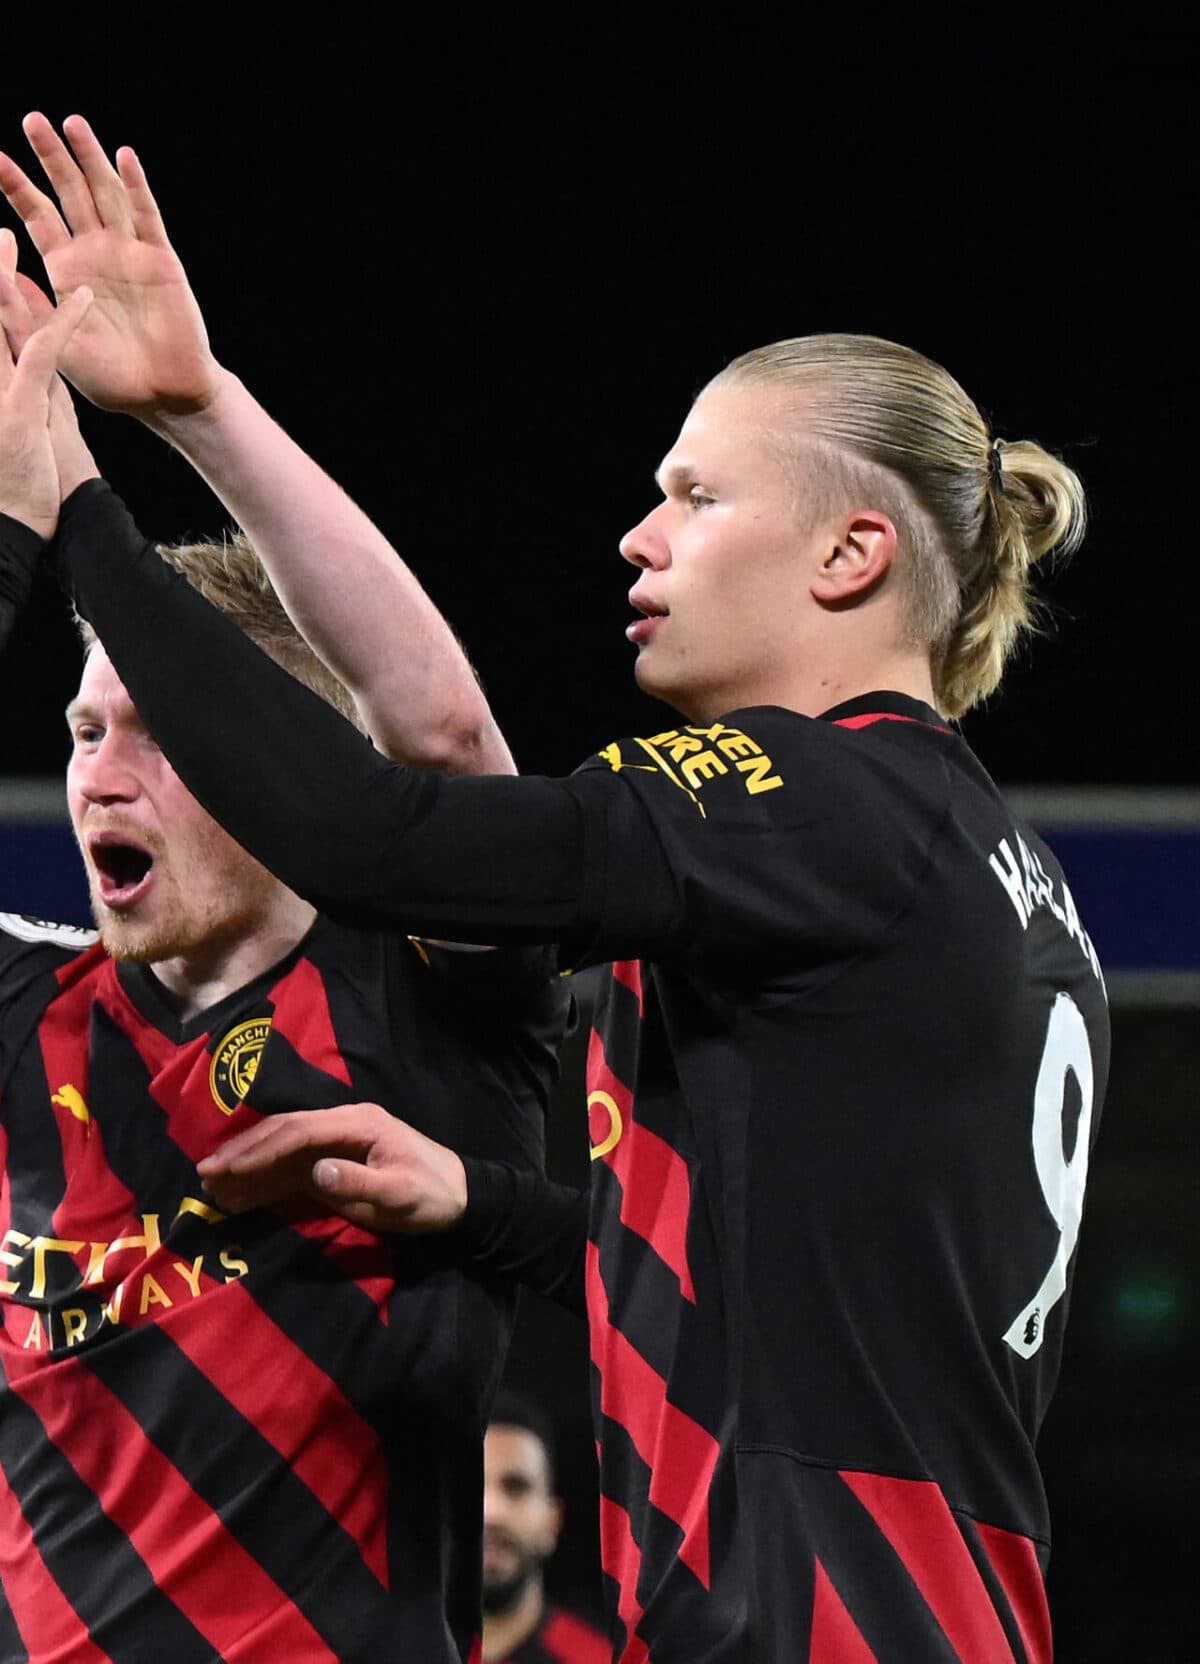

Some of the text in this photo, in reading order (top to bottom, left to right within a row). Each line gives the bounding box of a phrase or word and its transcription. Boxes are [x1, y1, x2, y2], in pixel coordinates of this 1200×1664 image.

[646, 730, 729, 789] IRE
[684, 723, 785, 795] XEN
[1002, 991, 1095, 1360] 9
